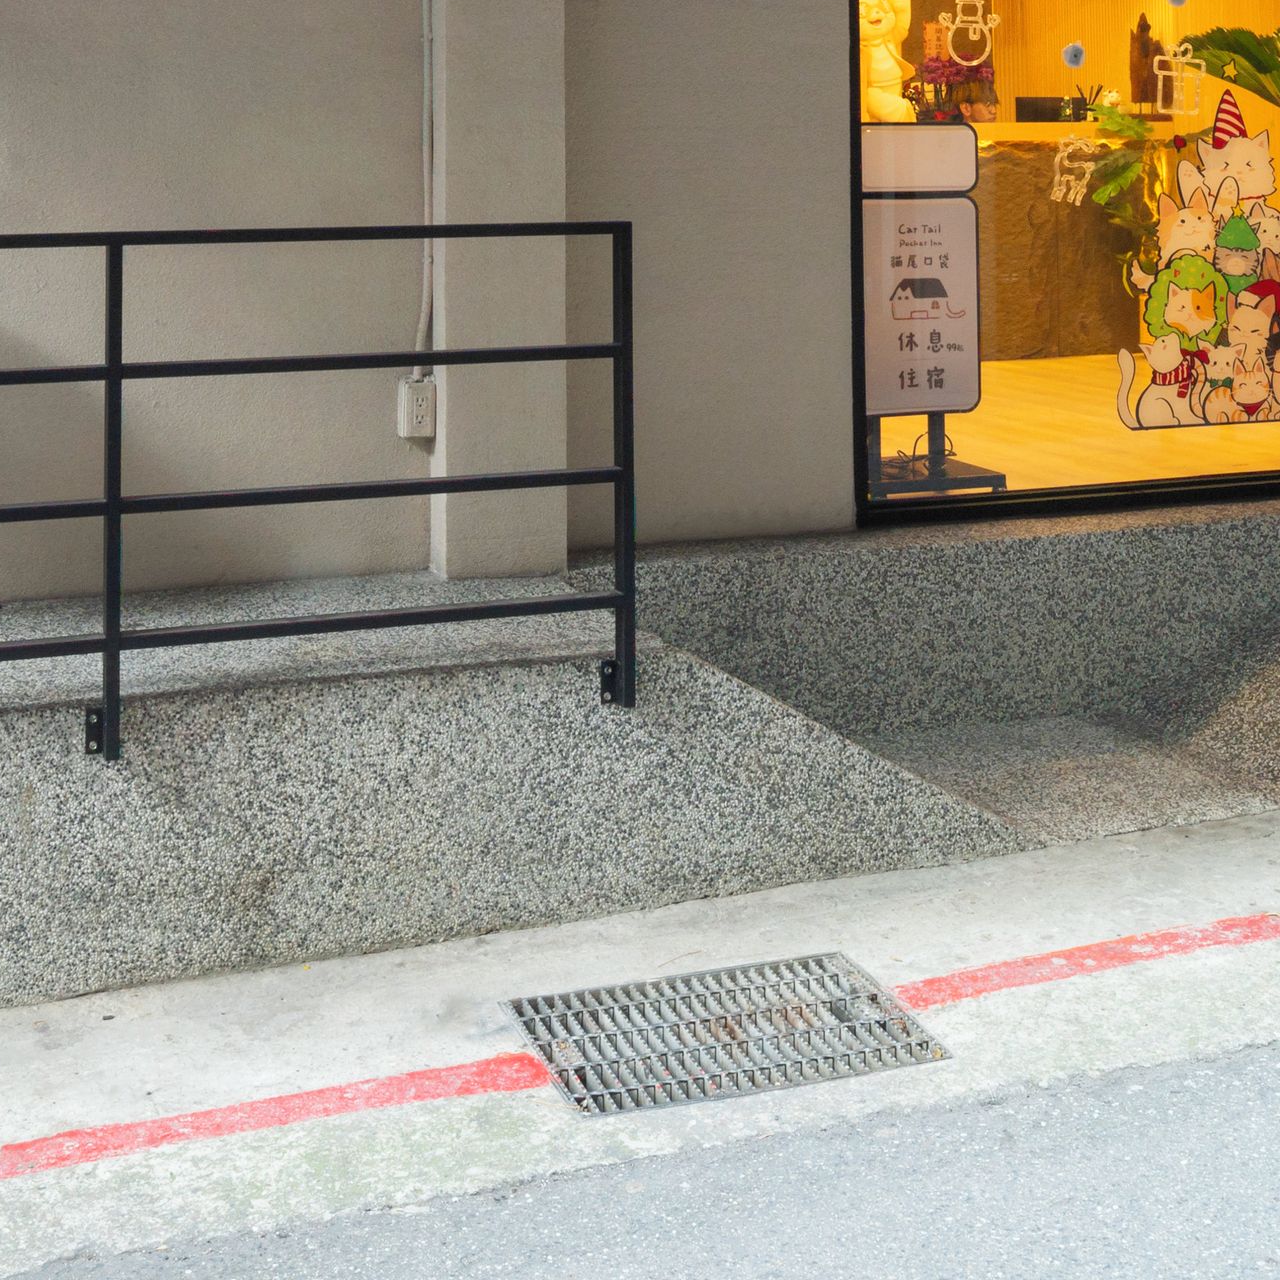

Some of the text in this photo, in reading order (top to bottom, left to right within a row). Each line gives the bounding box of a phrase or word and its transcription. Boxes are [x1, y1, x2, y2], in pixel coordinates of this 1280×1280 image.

[921, 224, 941, 234] Tail
[898, 328, 944, 353] 休息
[899, 366, 945, 390] 住宿
